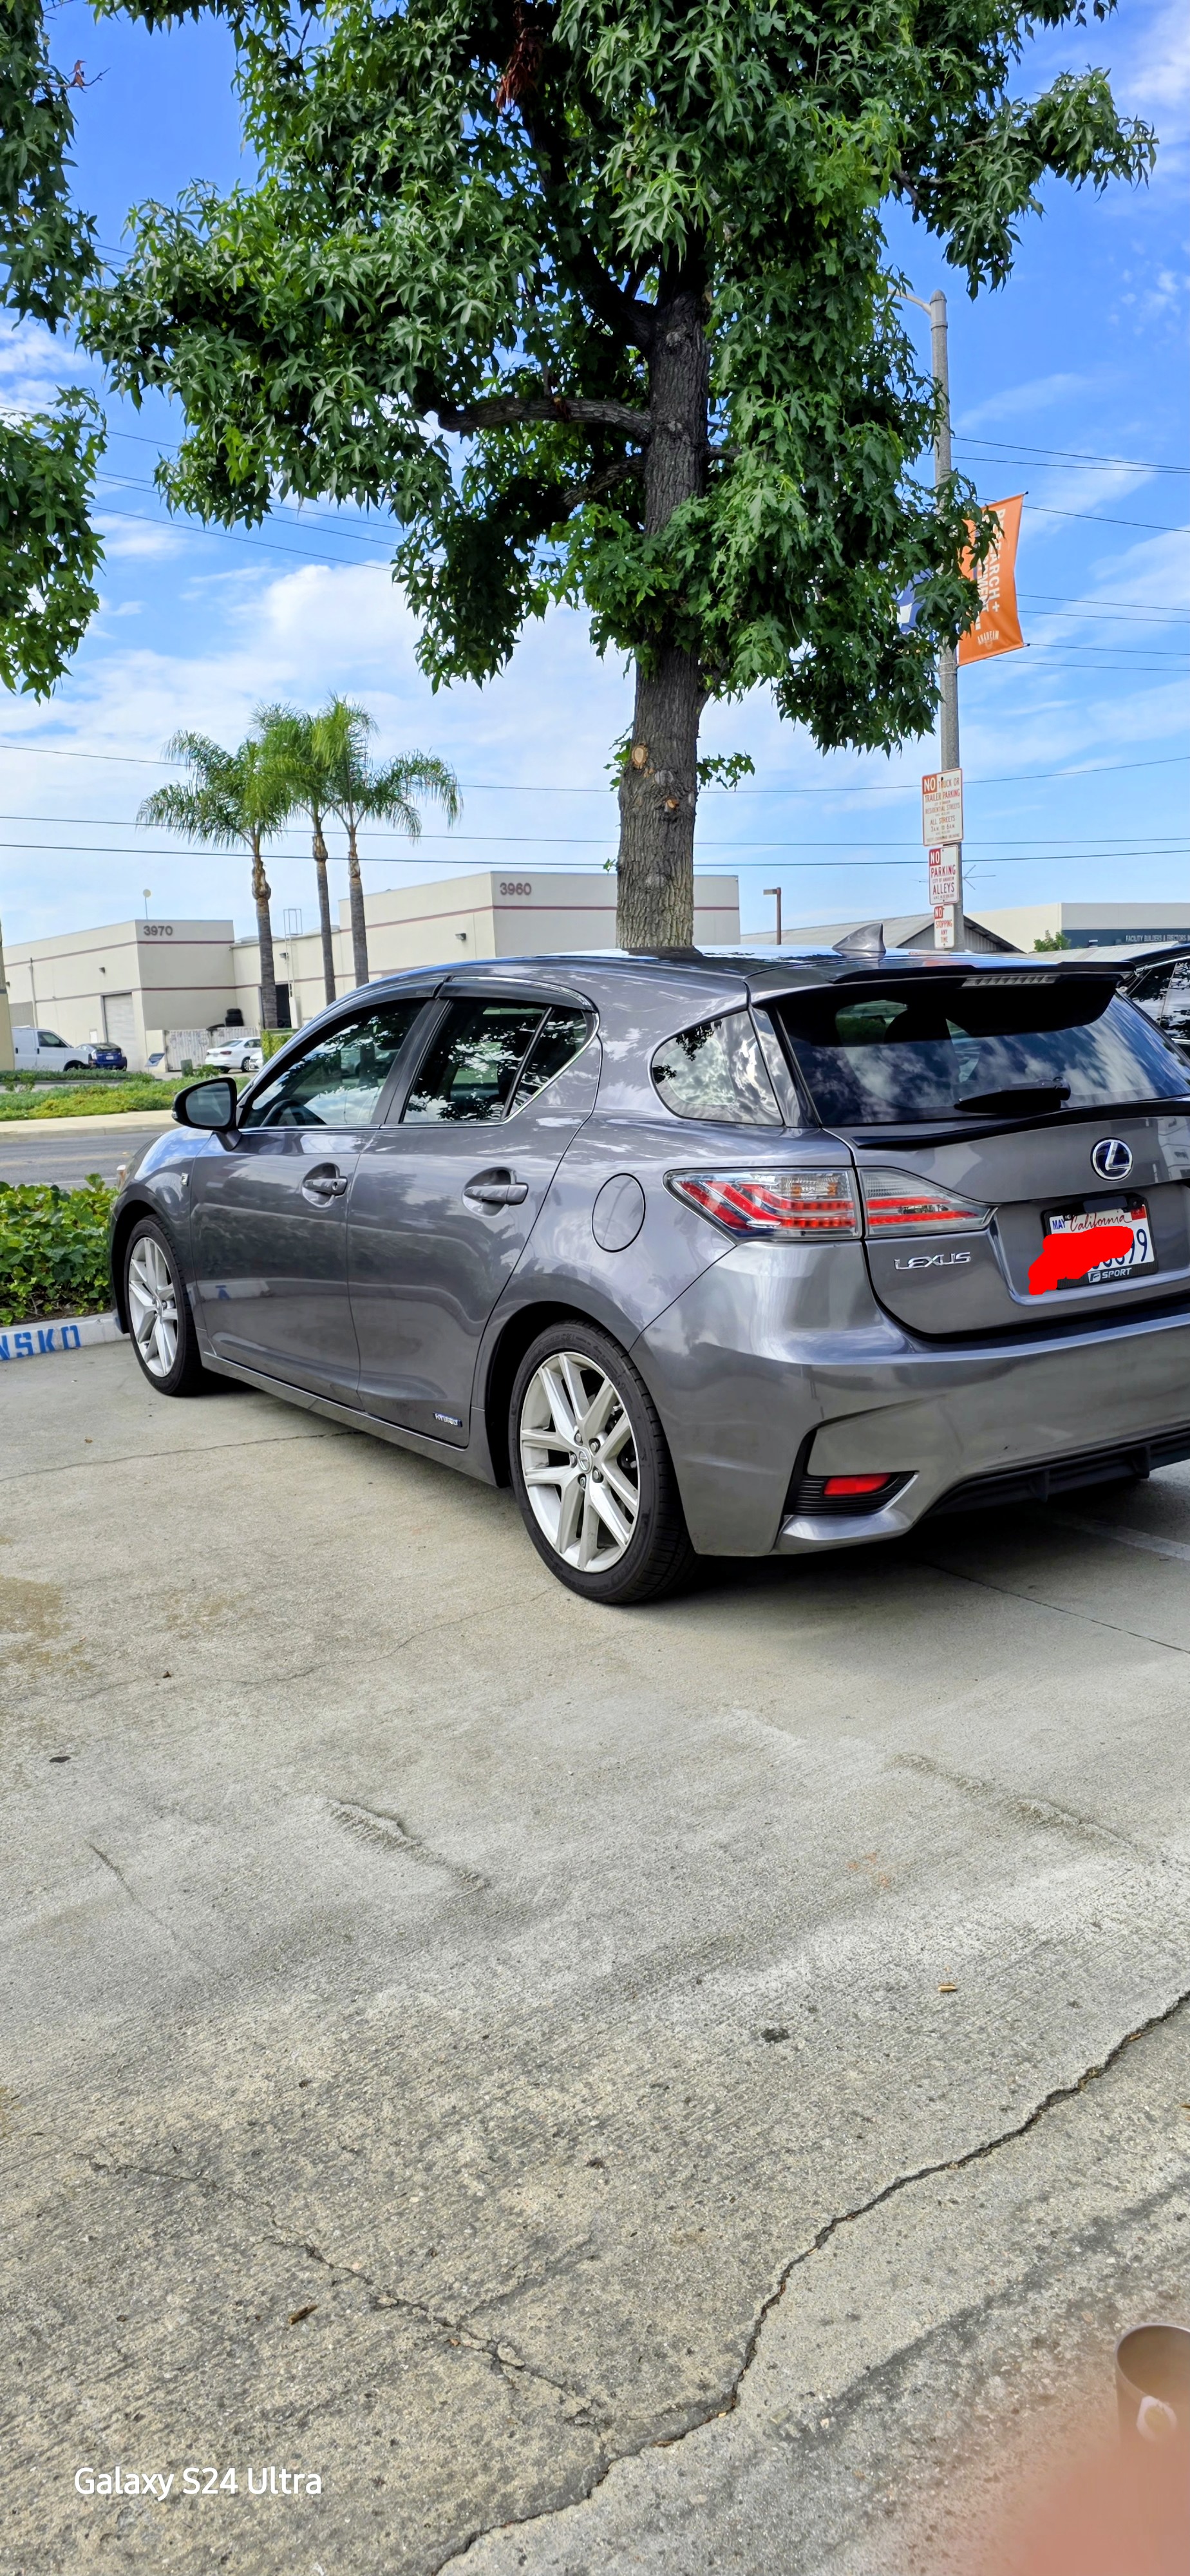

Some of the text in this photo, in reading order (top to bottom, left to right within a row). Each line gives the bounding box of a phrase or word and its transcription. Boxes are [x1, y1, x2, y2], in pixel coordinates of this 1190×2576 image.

[924, 777, 959, 792] NO TRUCK OR
[925, 788, 960, 802] TRAILER PARKING
[939, 815, 956, 824] STREETS
[930, 851, 940, 865] NO
[931, 864, 956, 878] PARKING
[500, 882, 532, 896] 3960
[933, 882, 955, 895] ALLEYS
[935, 907, 942, 918] NO
[143, 925, 173, 936] 3970
[936, 919, 952, 929] STOPPING
[1052, 1219, 1066, 1230] MAY
[1070, 1212, 1132, 1232] California
[894, 1251, 971, 1270] LEXUS
[1102, 1267, 1132, 1279] SPORT
